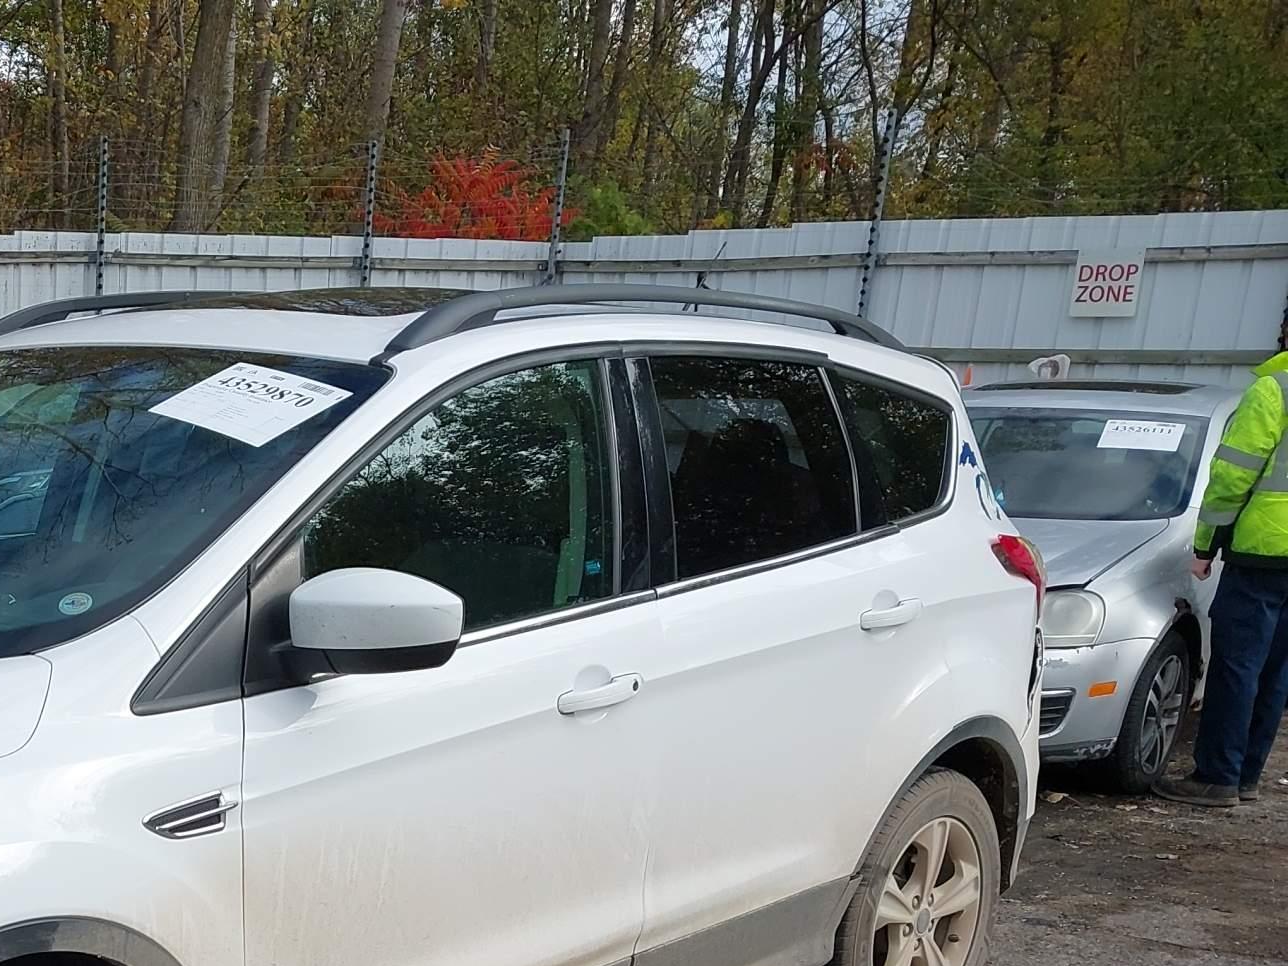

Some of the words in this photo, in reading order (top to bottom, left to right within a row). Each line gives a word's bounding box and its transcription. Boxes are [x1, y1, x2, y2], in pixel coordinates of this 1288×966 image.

[1078, 264, 1139, 282] DROP
[1074, 285, 1135, 303] ZONE
[218, 376, 314, 408] 43529870
